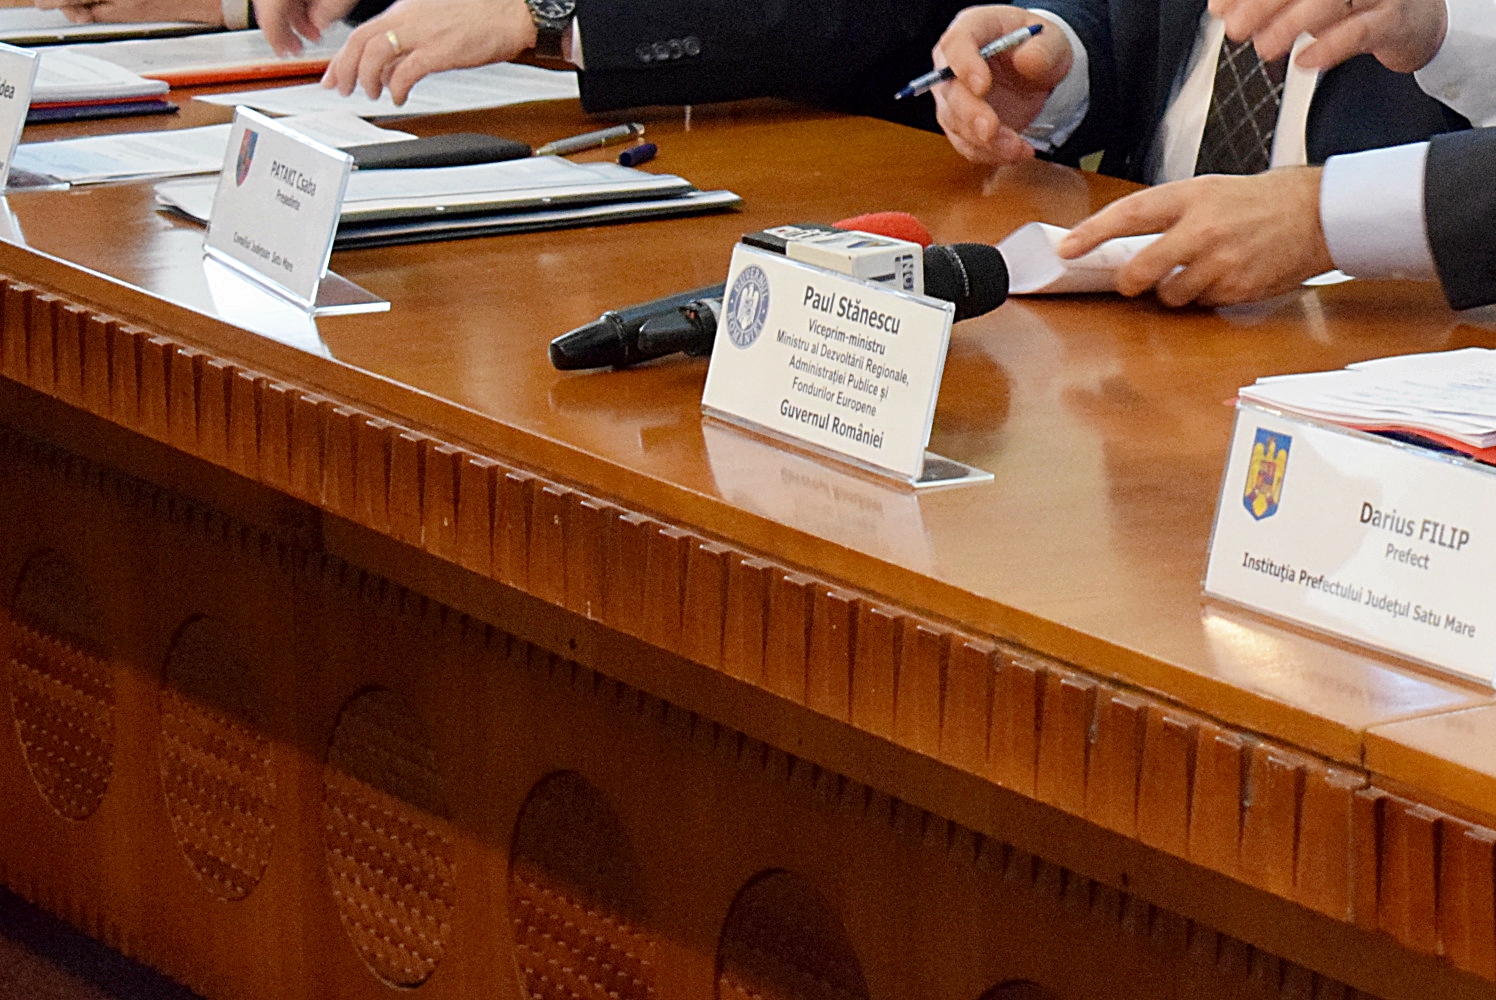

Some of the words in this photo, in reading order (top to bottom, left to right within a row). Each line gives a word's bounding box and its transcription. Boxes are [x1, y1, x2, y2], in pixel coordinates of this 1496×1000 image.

[270, 160, 297, 187] PATAKI
[296, 172, 317, 197] Csaba
[803, 285, 836, 314] Paul
[836, 296, 901, 335] Stănescu
[776, 329, 810, 351] Ministru
[811, 341, 819, 354] al
[820, 343, 865, 370] Dezvoltării
[865, 358, 909, 387] Regionale,
[808, 318, 886, 355] Viceprim-ministru
[792, 376, 835, 403] Fondurilor
[836, 391, 877, 416] Europene
[847, 373, 878, 396] Publice
[780, 398, 831, 430] Guvernul
[831, 416, 885, 449] României
[1359, 501, 1416, 537] Darius
[1419, 518, 1470, 551] FILIP
[1385, 542, 1431, 570] Prefect
[1298, 569, 1364, 603] Prefectului
[1412, 605, 1442, 627] Satu
[1443, 614, 1476, 638] Mare
